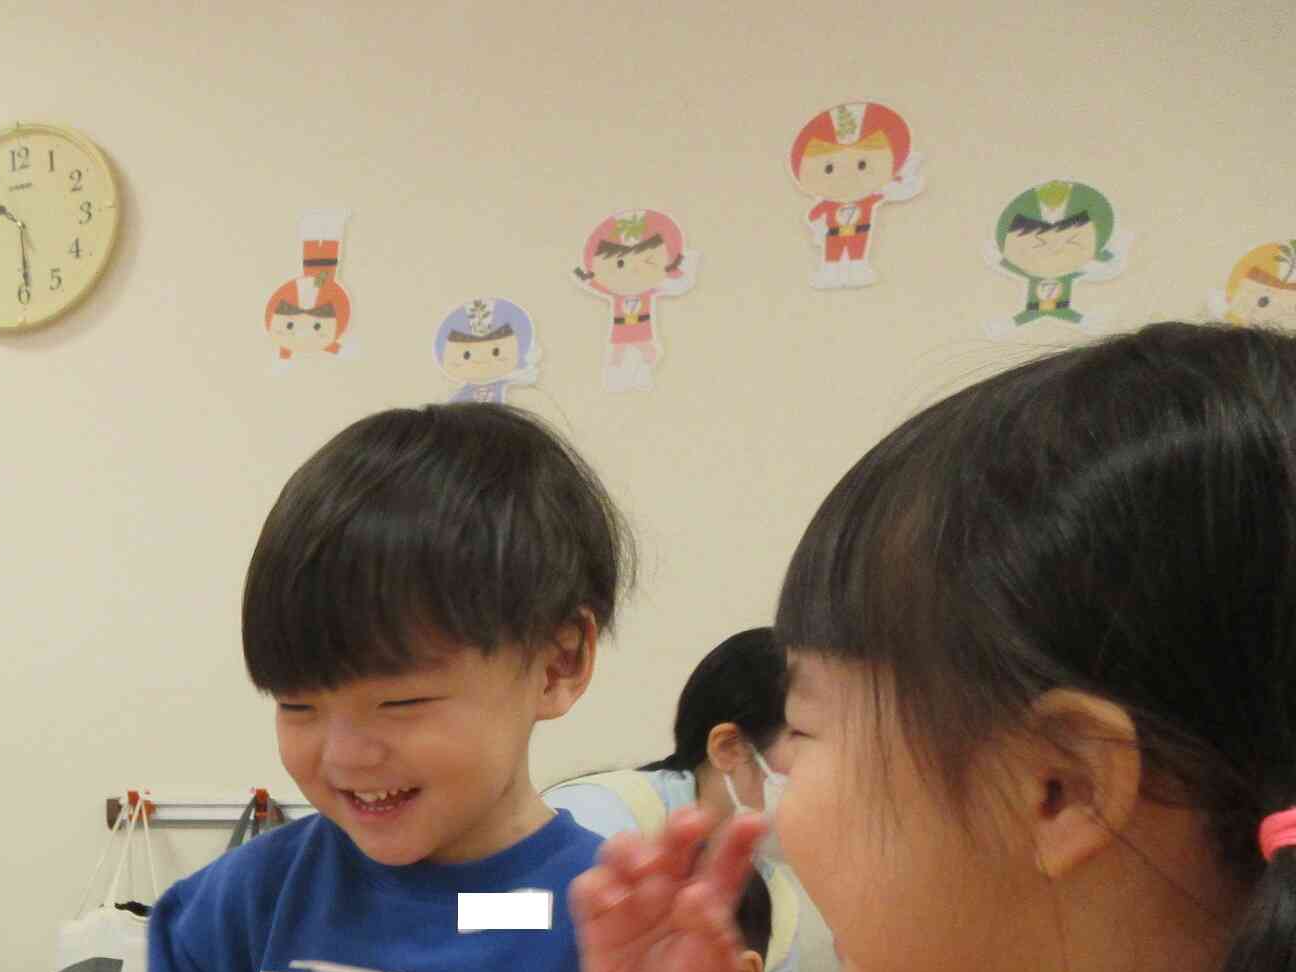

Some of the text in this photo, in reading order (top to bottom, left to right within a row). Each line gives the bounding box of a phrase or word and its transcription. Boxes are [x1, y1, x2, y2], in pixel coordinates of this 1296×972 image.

[10, 147, 30, 172] 12
[48, 150, 55, 173] 1
[69, 169, 82, 191] 2
[78, 200, 93, 225] 3
[68, 237, 83, 259] 4
[50, 268, 62, 290] 5
[16, 282, 31, 305] 6
